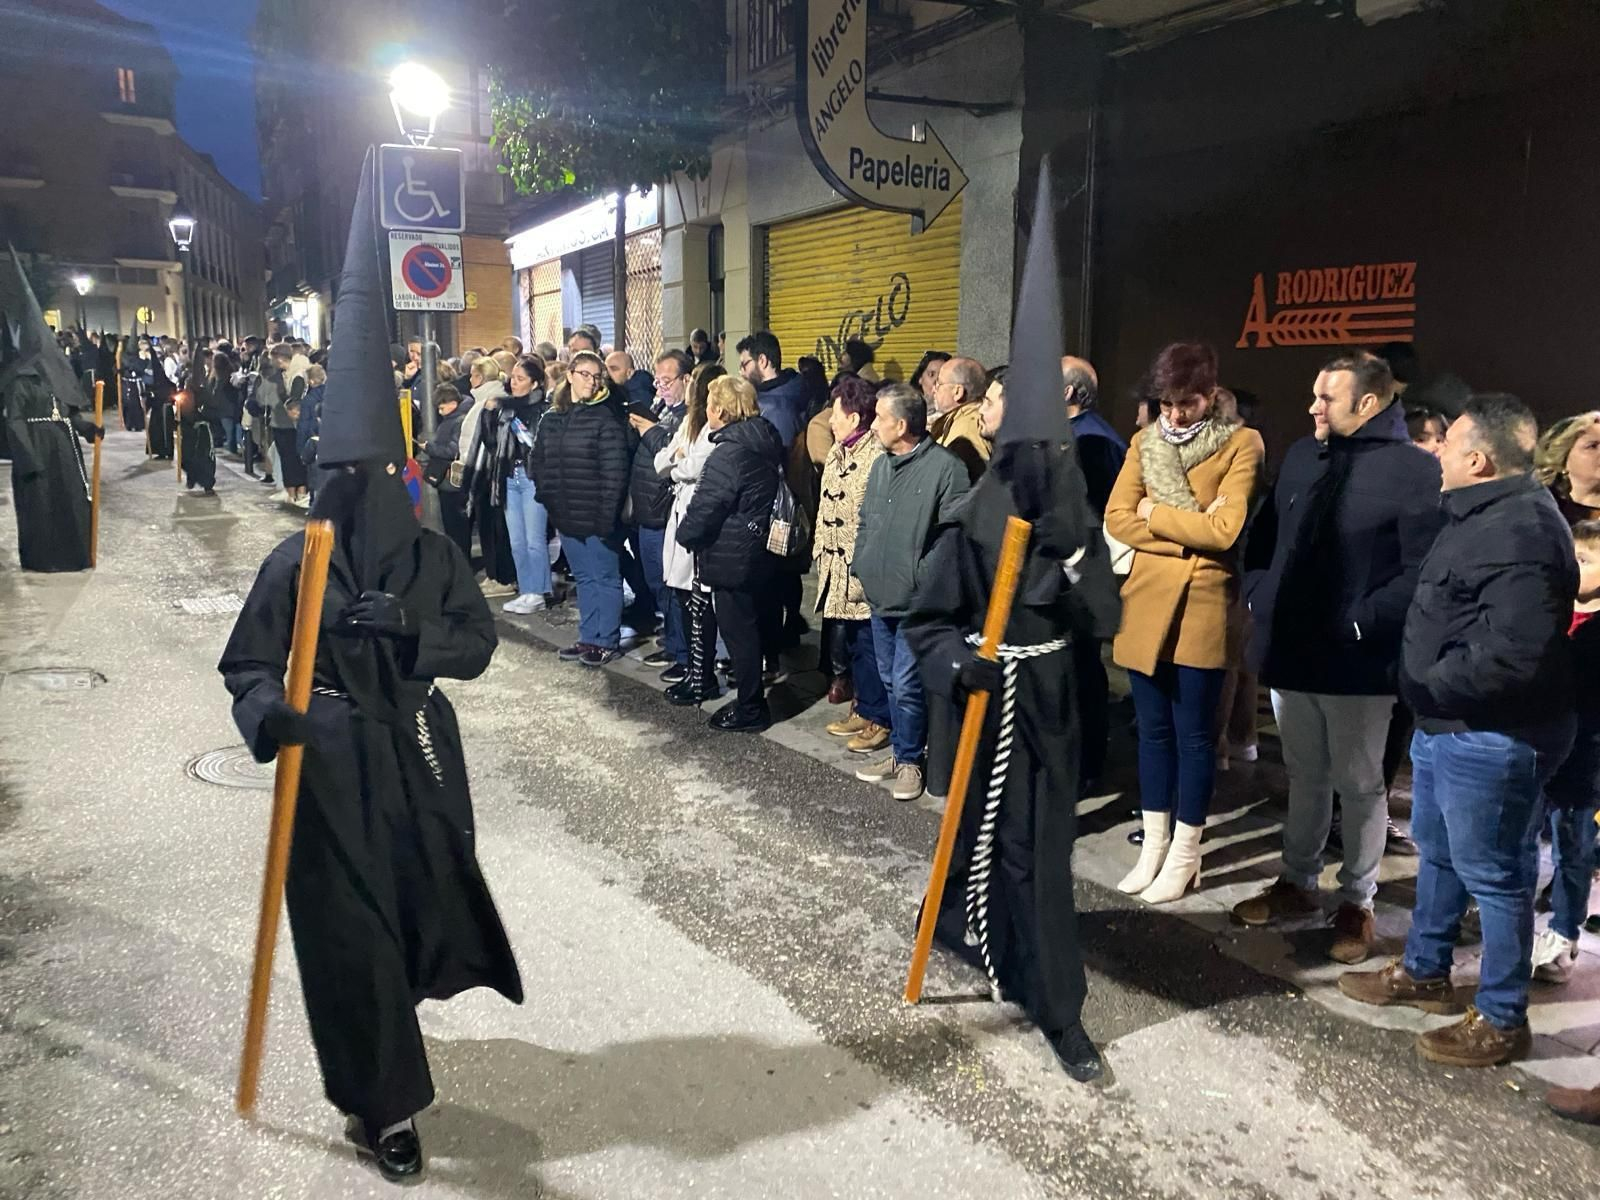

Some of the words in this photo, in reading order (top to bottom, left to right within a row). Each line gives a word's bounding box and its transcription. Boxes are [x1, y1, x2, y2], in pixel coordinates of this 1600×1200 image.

[812, 0, 863, 78] libreri
[815, 59, 863, 141] ANGELO
[849, 147, 950, 191] Papeleria
[391, 233, 422, 241] RESERVADO
[1235, 272, 1273, 348] A
[1275, 262, 1417, 305] RODRIGUEZ
